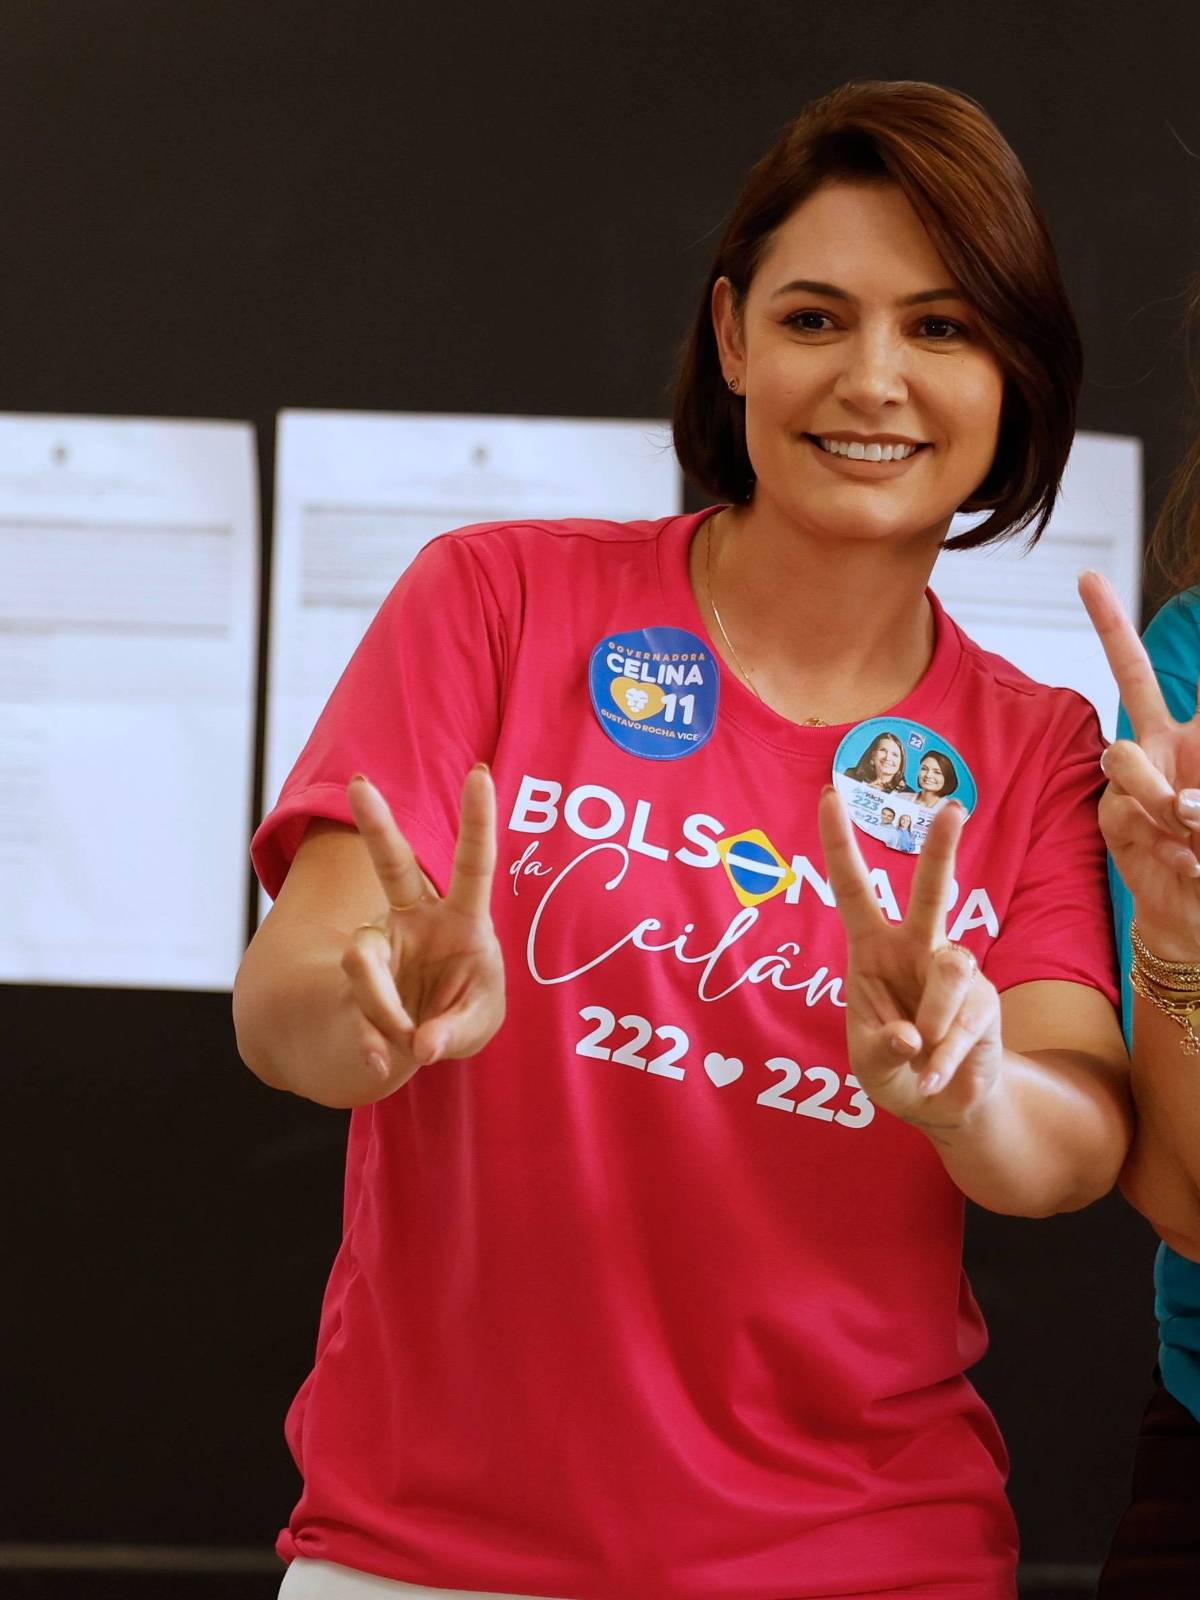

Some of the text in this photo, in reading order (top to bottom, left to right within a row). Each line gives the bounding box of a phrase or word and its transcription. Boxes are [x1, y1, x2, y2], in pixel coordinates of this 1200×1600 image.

[608, 642, 706, 661] GOVERNADORA
[606, 652, 704, 686] CELINA
[600, 708, 699, 741] GUSTAVO ROCHA VICE
[661, 693, 695, 725] 11
[509, 840, 848, 1007] da Ceilân
[575, 1005, 876, 1129] 222 223
